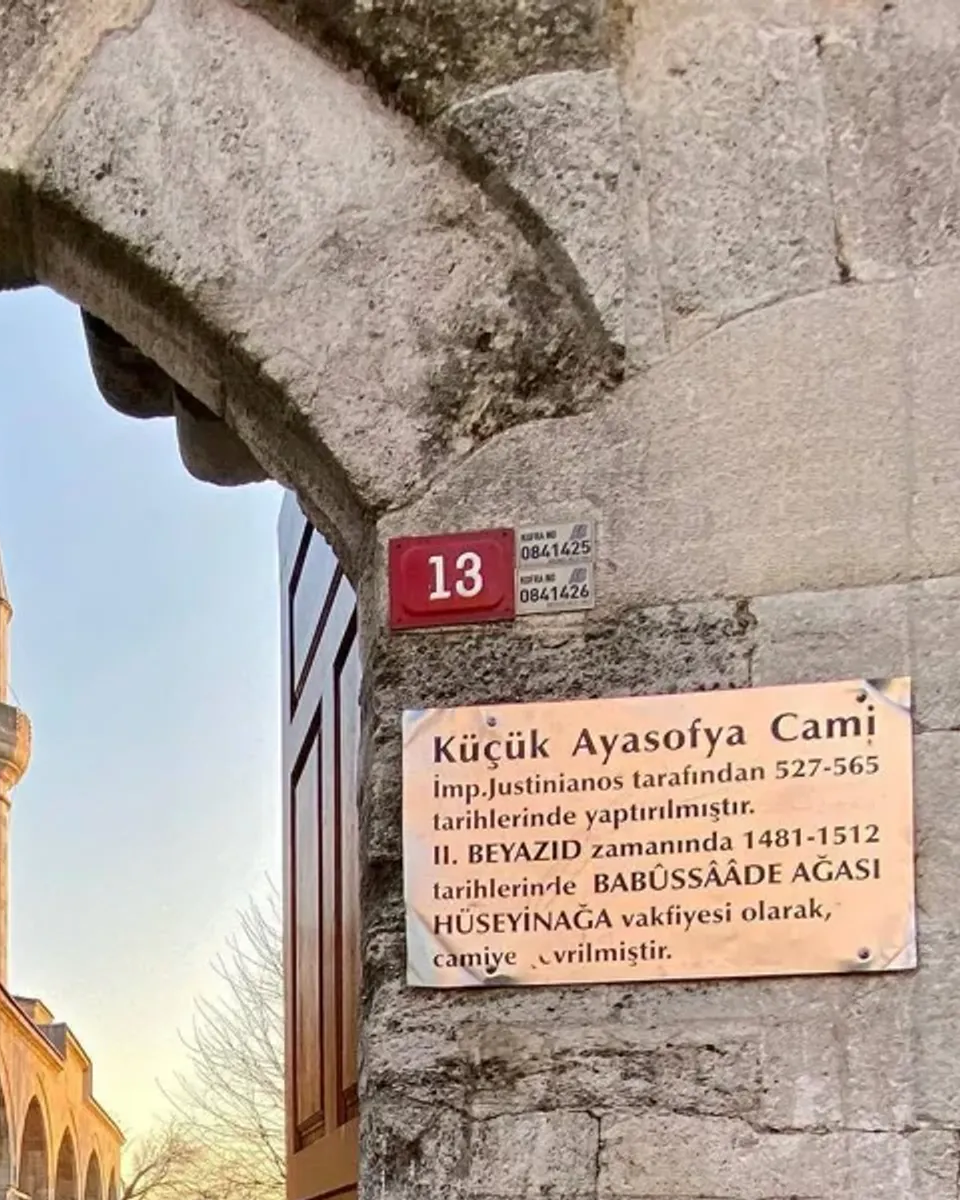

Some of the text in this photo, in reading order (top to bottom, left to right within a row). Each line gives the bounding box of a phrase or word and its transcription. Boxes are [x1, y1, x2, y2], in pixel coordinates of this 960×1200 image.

[521, 540, 591, 560] 0841425
[428, 551, 484, 600] 13
[520, 583, 590, 603] 0841426
[434, 704, 876, 770] Küçük Ayasofya Cami
[633, 763, 766, 789] tarafından
[775, 755, 880, 780] 527-565
[434, 799, 755, 831] tarihlerinde yaptırılmıştır.
[434, 824, 880, 866] II. BEYAZID zamanında 1481-1512
[434, 854, 882, 901] tarihlerinde BABÛSSÂÂDE AĞASI
[433, 898, 833, 936] HÜSEYİNAĞA vakfiyesi olarak,
[433, 946, 518, 973] camiye
